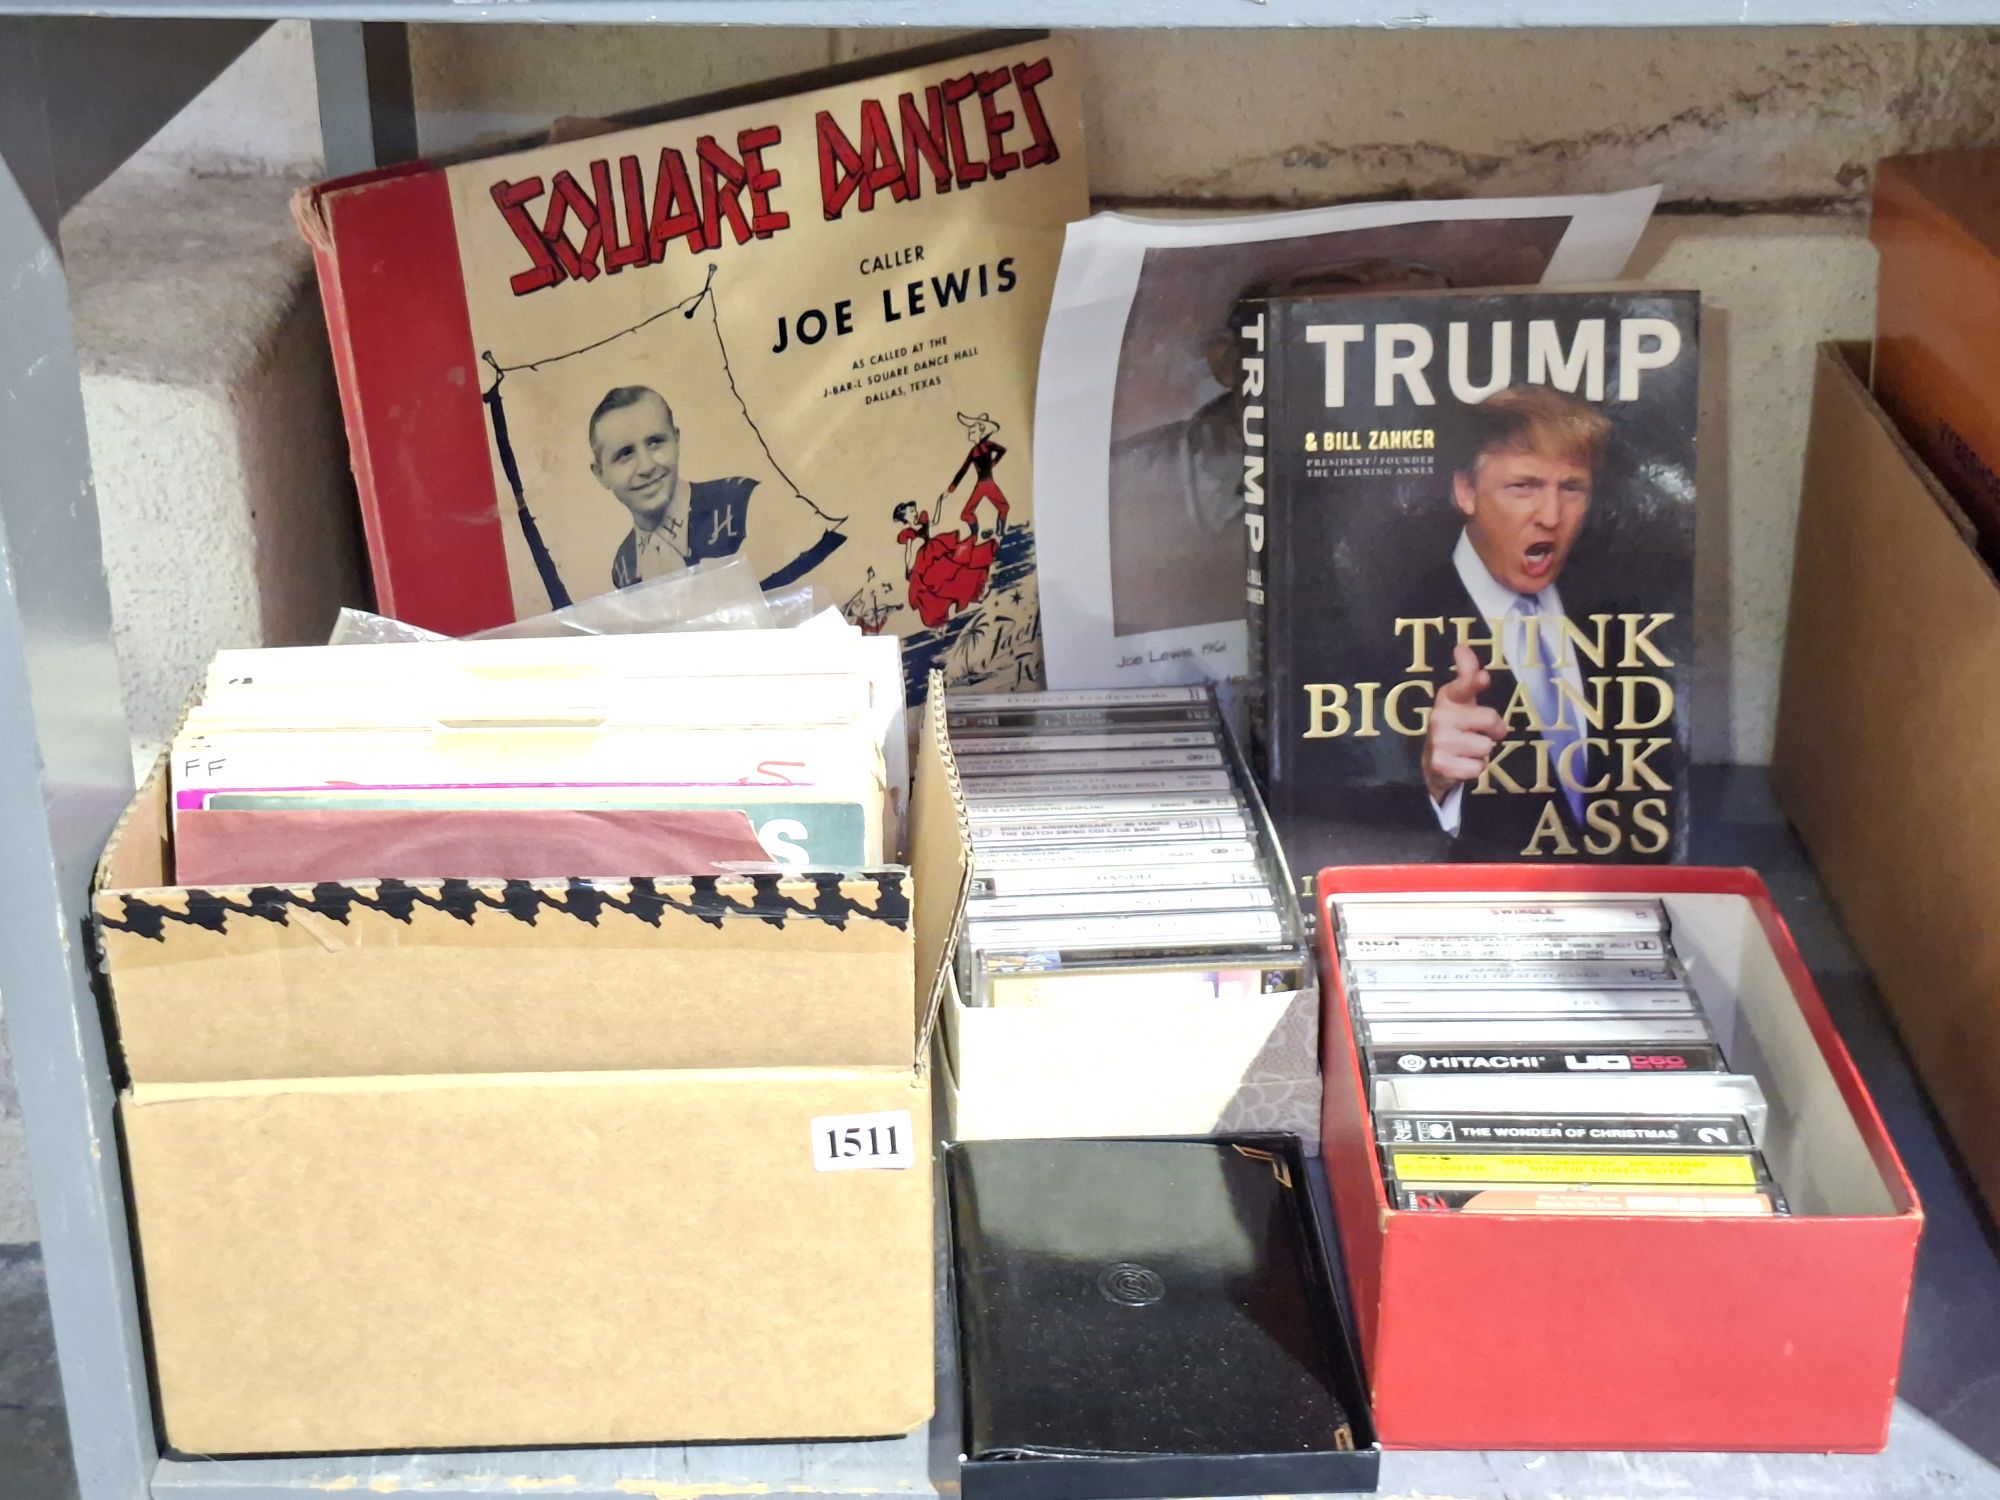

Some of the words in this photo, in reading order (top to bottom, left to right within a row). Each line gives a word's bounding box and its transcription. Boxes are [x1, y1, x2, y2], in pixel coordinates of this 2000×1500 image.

[490, 124, 790, 296] SQUARE
[815, 57, 1061, 220] DANCES
[859, 245, 926, 276] CALLER
[771, 300, 854, 353] JOE
[883, 257, 1019, 323] LEWIS
[852, 358, 865, 370] AS
[870, 347, 908, 366] CALLED
[911, 342, 924, 353] AT
[929, 335, 948, 348] THE
[867, 366, 909, 386] SQUARE
[914, 354, 949, 372] DANCE
[954, 347, 979, 361] HALL
[1305, 318, 1682, 408] TRUMP
[865, 386, 907, 405] DALLAS,
[910, 375, 942, 392] TEXAS
[1241, 312, 1265, 553] TRUMP
[1305, 431, 1318, 452] &
[1323, 431, 1362, 451] BILL
[1368, 429, 1435, 450] ZANKER
[1306, 469, 1330, 478] THE
[1334, 467, 1392, 477] LEARNING
[1394, 466, 1435, 475] ANNEX
[1394, 612, 1676, 673] THINK
[1302, 679, 1437, 739] BIG
[1503, 675, 1675, 732] AND
[1470, 737, 1673, 796] KICK
[1519, 799, 1671, 856] ASS
[1429, 1056, 1538, 1068] HITACHI
[826, 1125, 900, 1158] 1511
[1460, 1126, 1492, 1138] THE
[1493, 1126, 1562, 1139] WONDER
[1563, 1127, 1587, 1139] OF
[1588, 1127, 1678, 1140] CHRISTMAS
